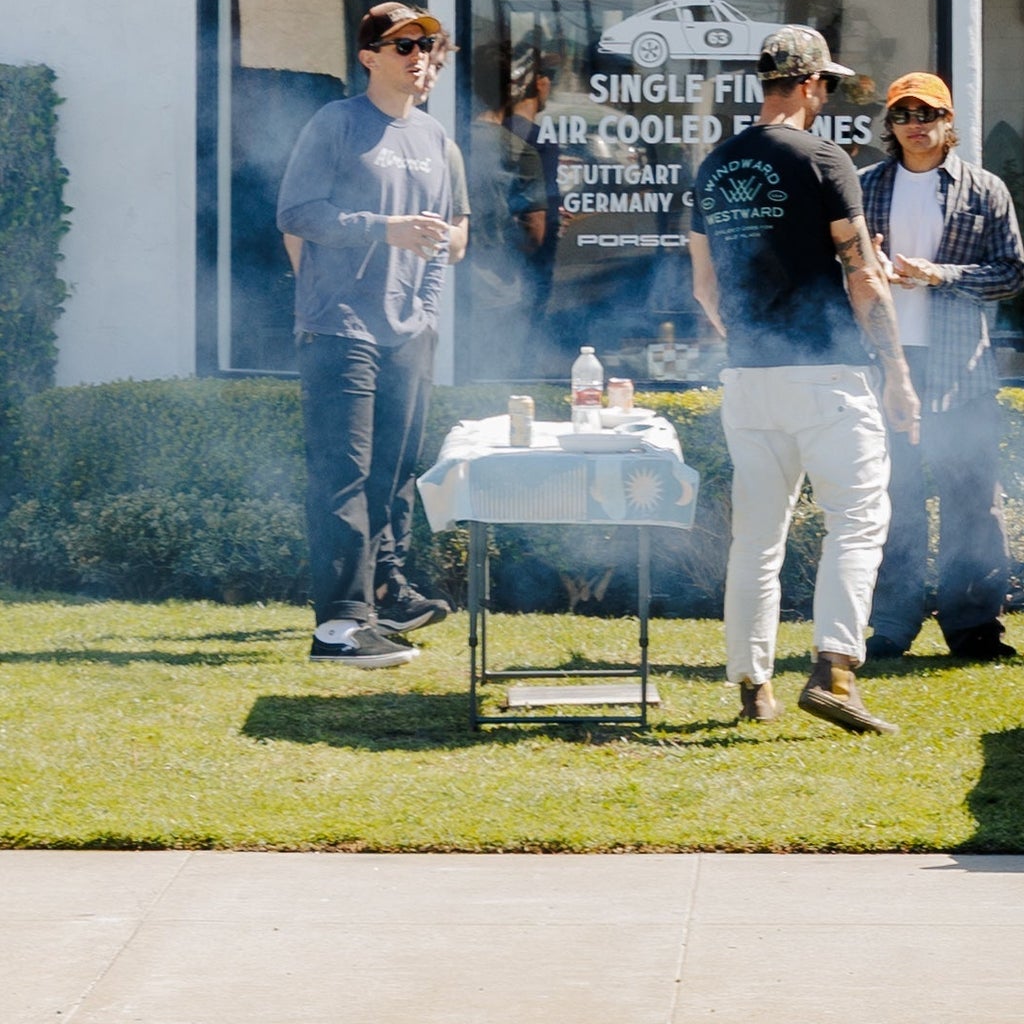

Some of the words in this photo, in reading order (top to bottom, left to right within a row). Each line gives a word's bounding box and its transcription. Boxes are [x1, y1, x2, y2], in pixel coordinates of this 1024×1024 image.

[708, 31, 729, 45] 63
[589, 73, 704, 103] SINGLE
[537, 114, 588, 144] AIR
[598, 114, 722, 144] COOLED
[733, 114, 872, 144] ENES
[556, 164, 682, 184] STUTTGART
[704, 158, 780, 192] WINDWARD
[563, 192, 673, 213] GERMANY
[706, 207, 784, 226] WESTWARD
